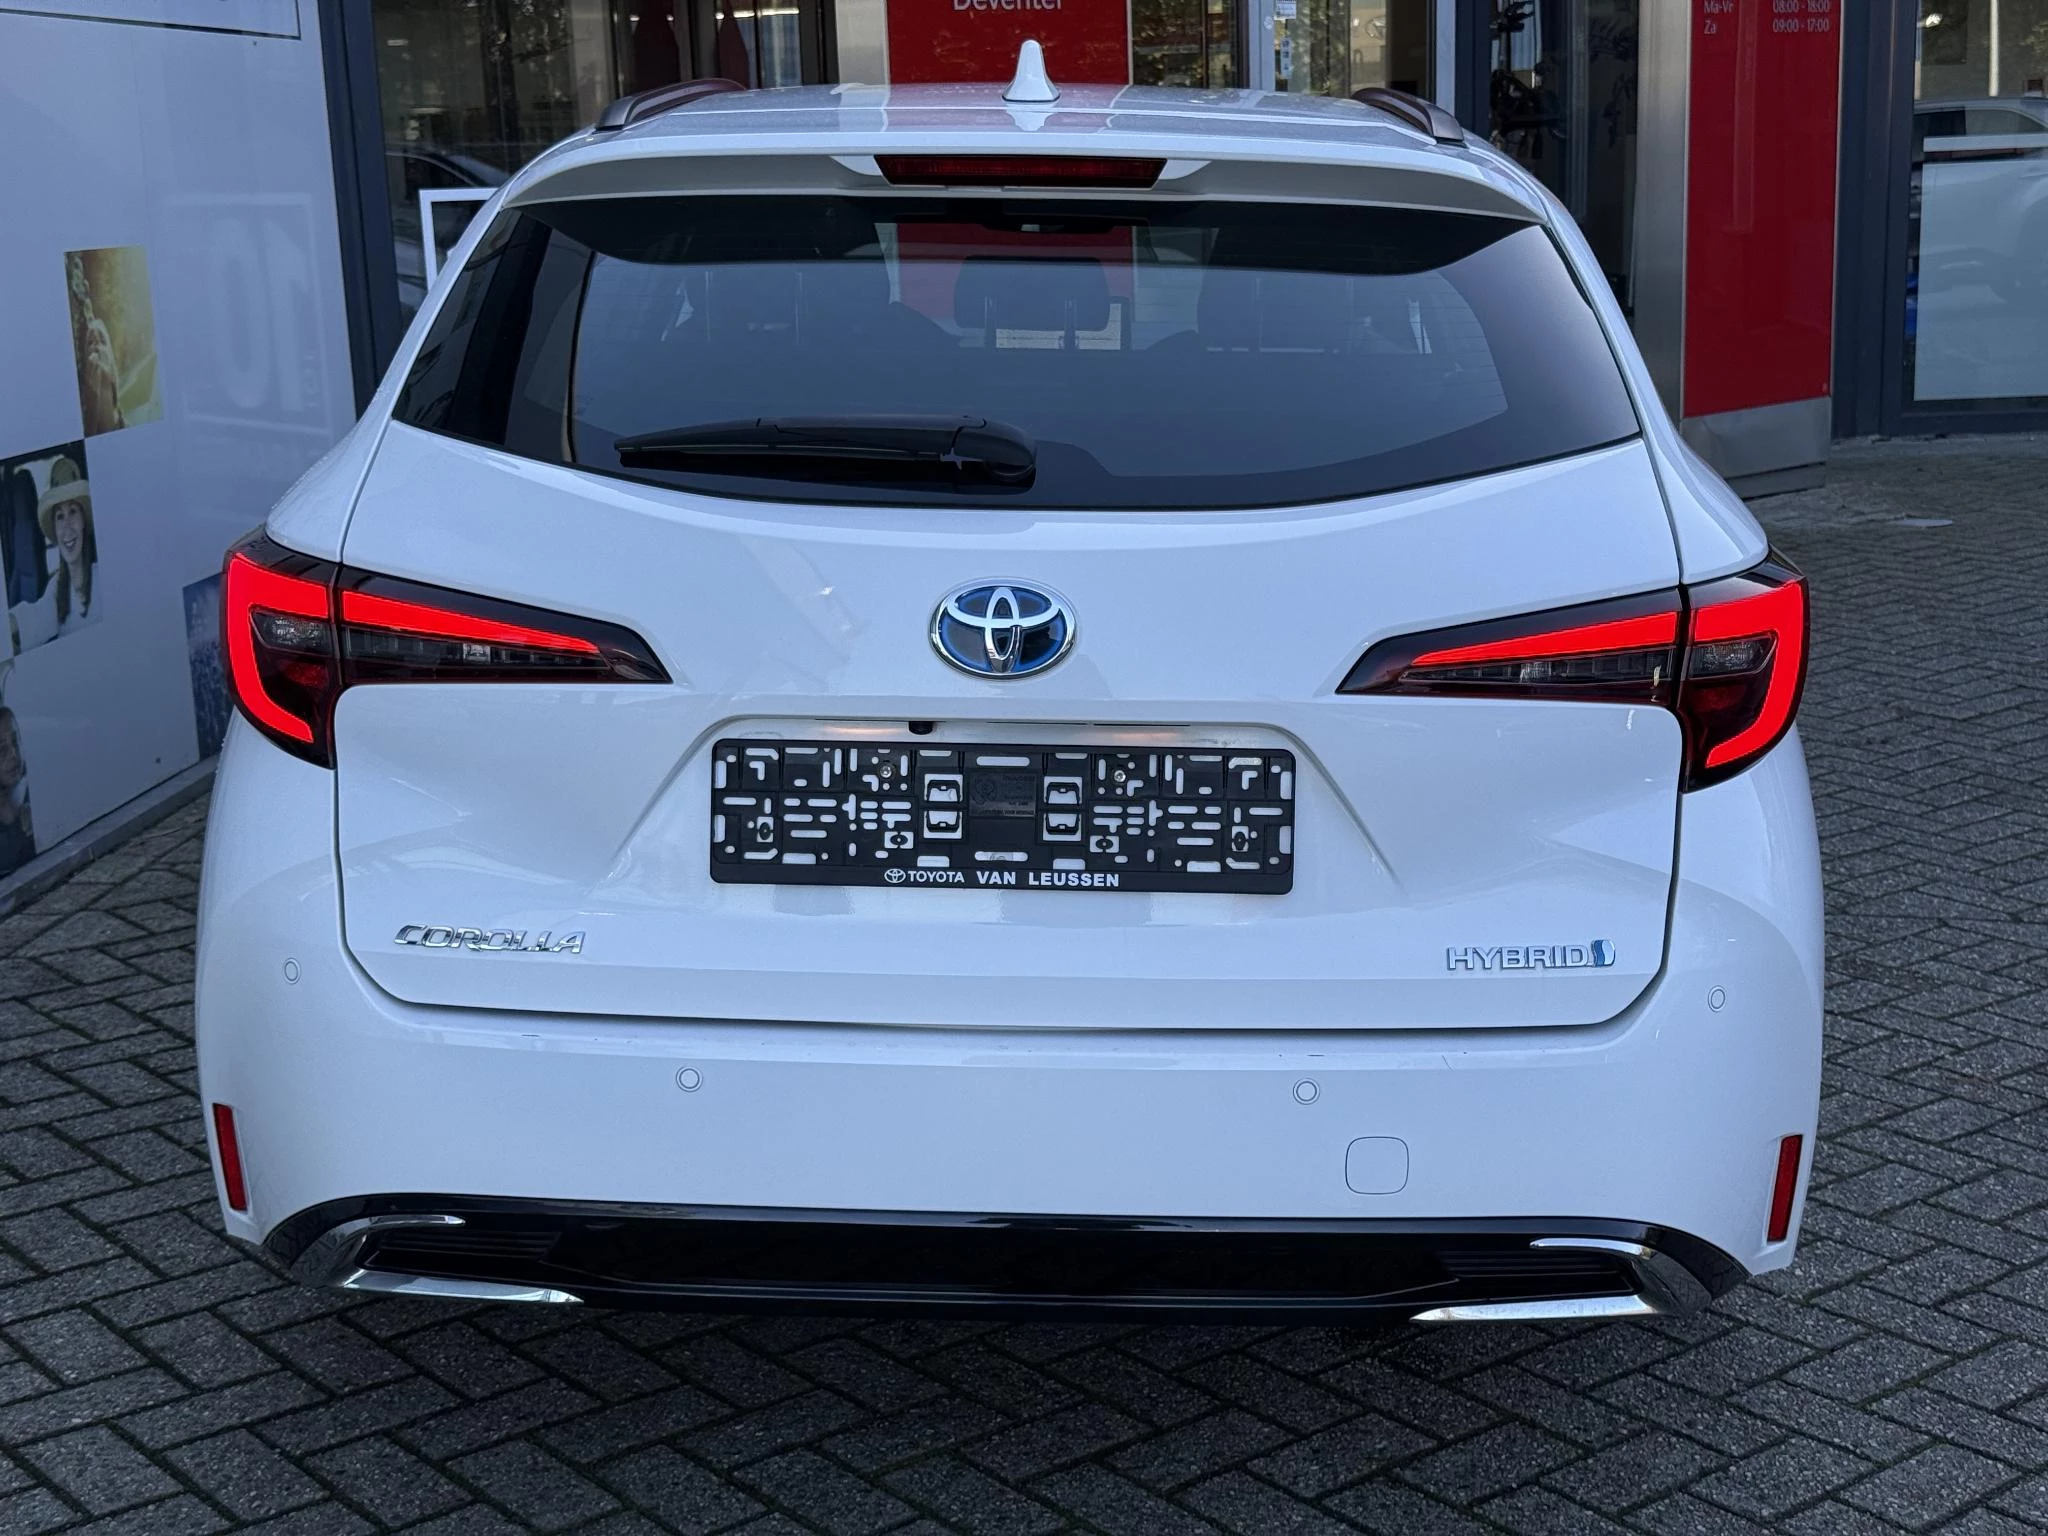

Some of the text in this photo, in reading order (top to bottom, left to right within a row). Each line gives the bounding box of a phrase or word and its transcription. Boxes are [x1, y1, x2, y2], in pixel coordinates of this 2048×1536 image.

[1703, 0, 1734, 13] Ma-Vr
[1772, 0, 1799, 13] 08:00
[1807, 0, 1830, 13] 18:00
[1703, 20, 1717, 34] Za
[1772, 18, 1799, 33] 09:00
[1807, 18, 1830, 32] 17:00
[908, 870, 1119, 887] TOYOTA VAN LEUSSEN
[394, 924, 586, 954] COROLLA
[1446, 945, 1590, 971] HYBRID
